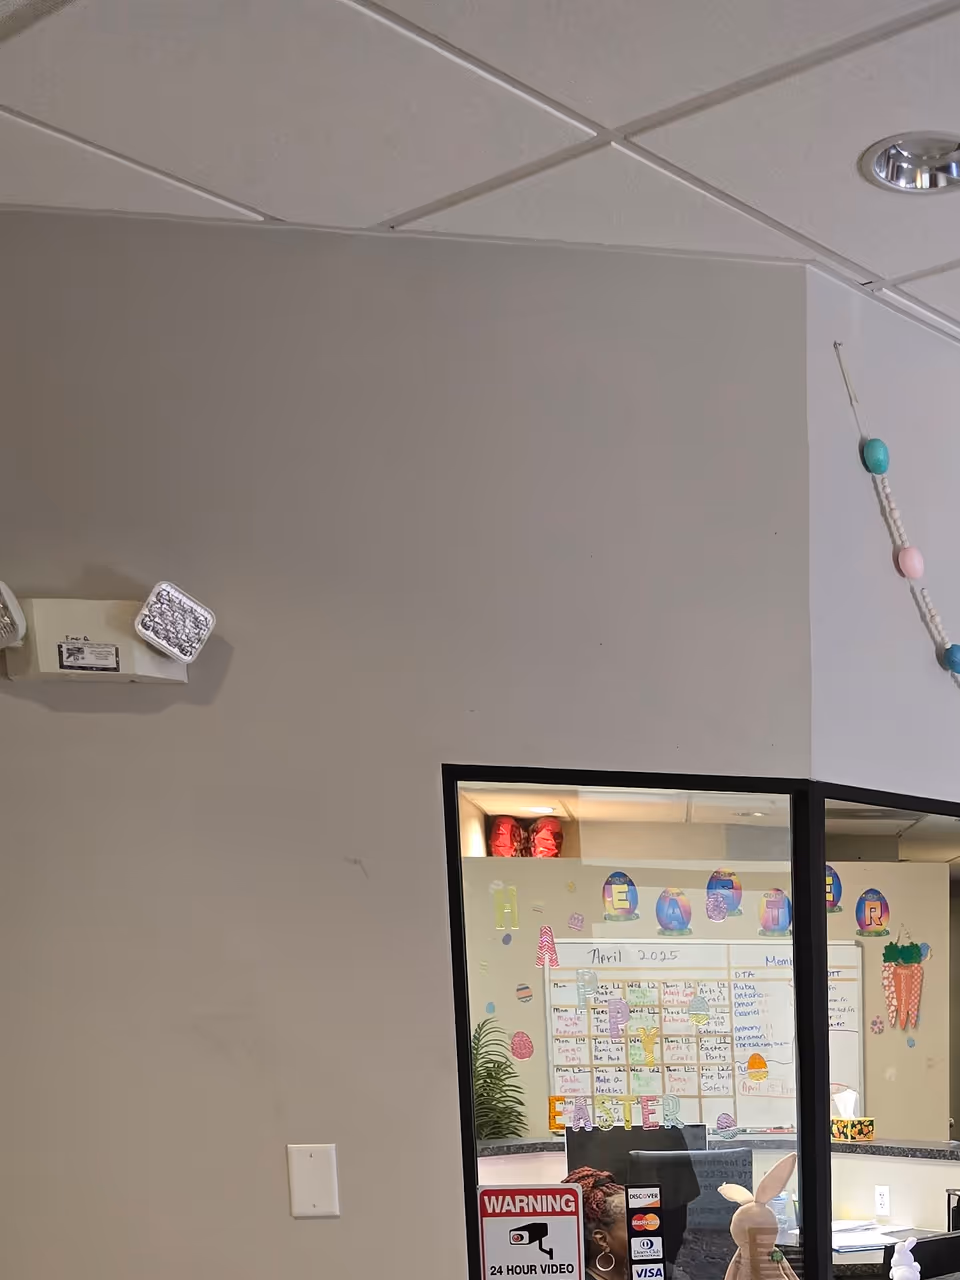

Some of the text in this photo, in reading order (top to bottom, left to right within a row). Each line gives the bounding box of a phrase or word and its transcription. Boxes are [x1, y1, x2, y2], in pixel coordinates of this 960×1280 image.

[588, 948, 680, 964] April 2025
[734, 983, 756, 991] Ruby
[705, 1053, 726, 1061] Party
[702, 1082, 729, 1094] Safety
[742, 1081, 760, 1093] April
[548, 1095, 685, 1131] EASTER
[629, 1192, 659, 1200] DISCOVER
[484, 1195, 576, 1213] WARNING
[490, 1263, 575, 1276] 24 HOUR VIDEO
[635, 1267, 663, 1278] VISA
